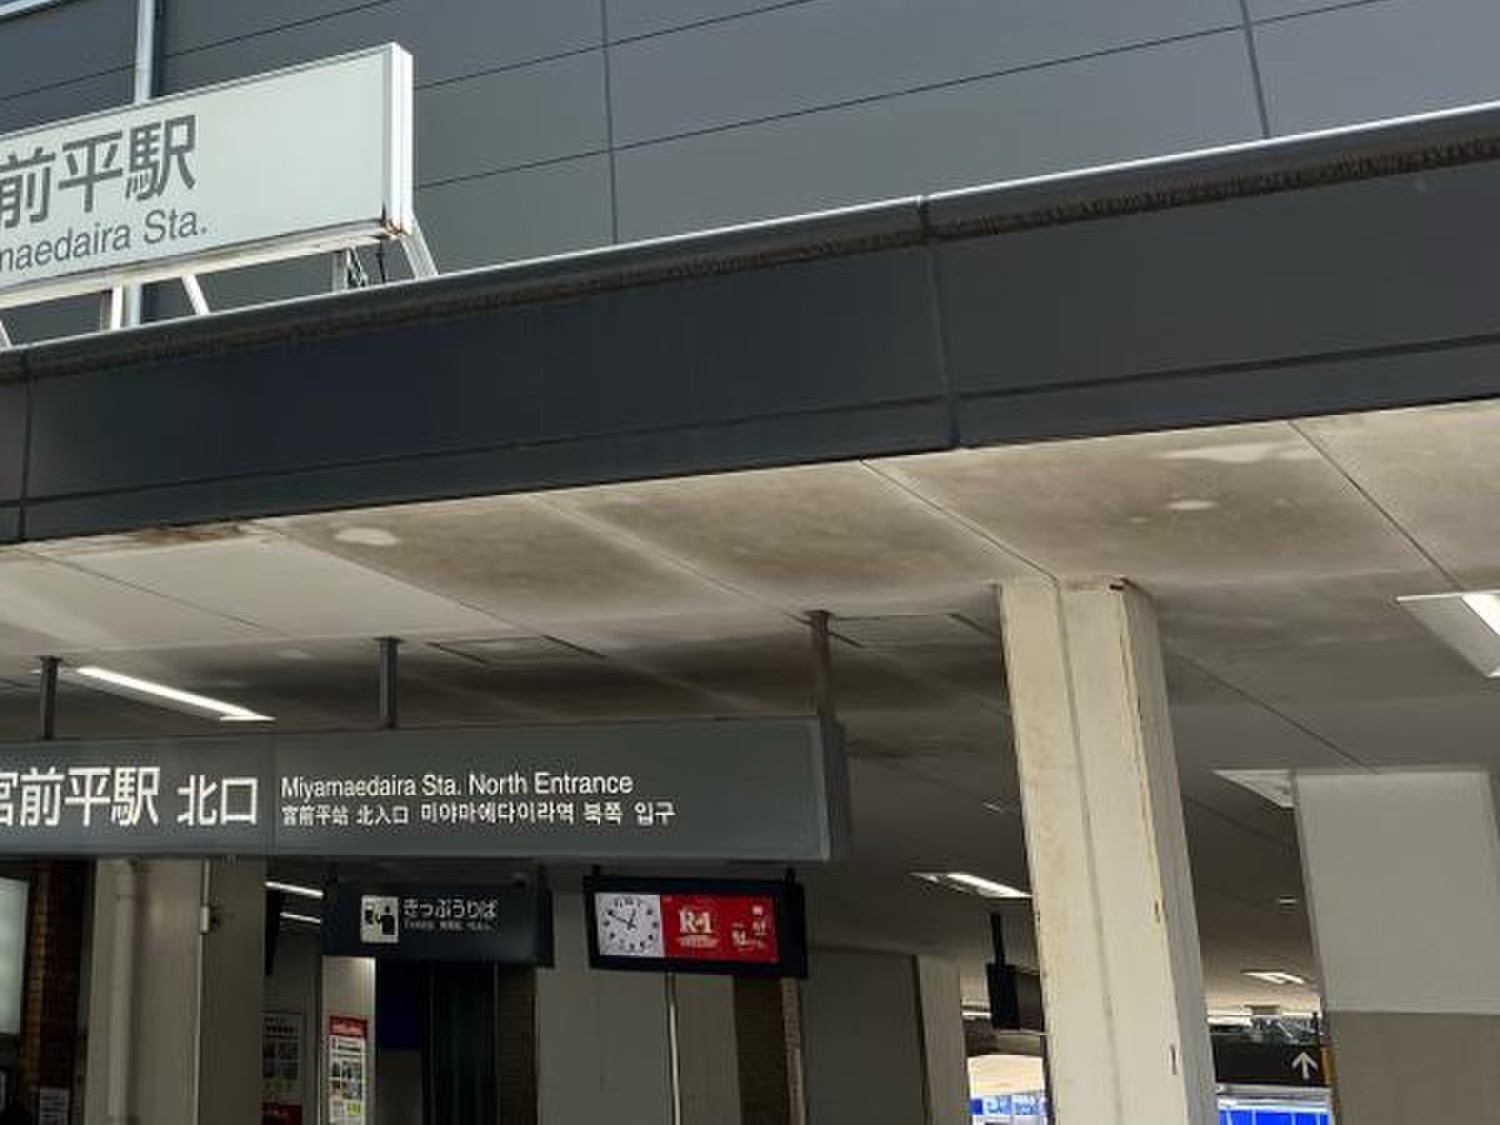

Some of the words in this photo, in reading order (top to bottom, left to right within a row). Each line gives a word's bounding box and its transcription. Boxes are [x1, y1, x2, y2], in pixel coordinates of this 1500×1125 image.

[144, 206, 208, 244] Sta.
[281, 775, 416, 800] Miyamaedaira
[421, 774, 461, 796] Sta.
[468, 773, 529, 796] North
[534, 772, 632, 795] Entrance
[177, 777, 257, 826] 北口
[421, 802, 575, 825] 미야마에다이라역
[584, 802, 622, 826] 북쪽
[635, 802, 676, 826] 입구
[356, 804, 409, 826] 北入口
[403, 898, 497, 918] きっぷうりば
